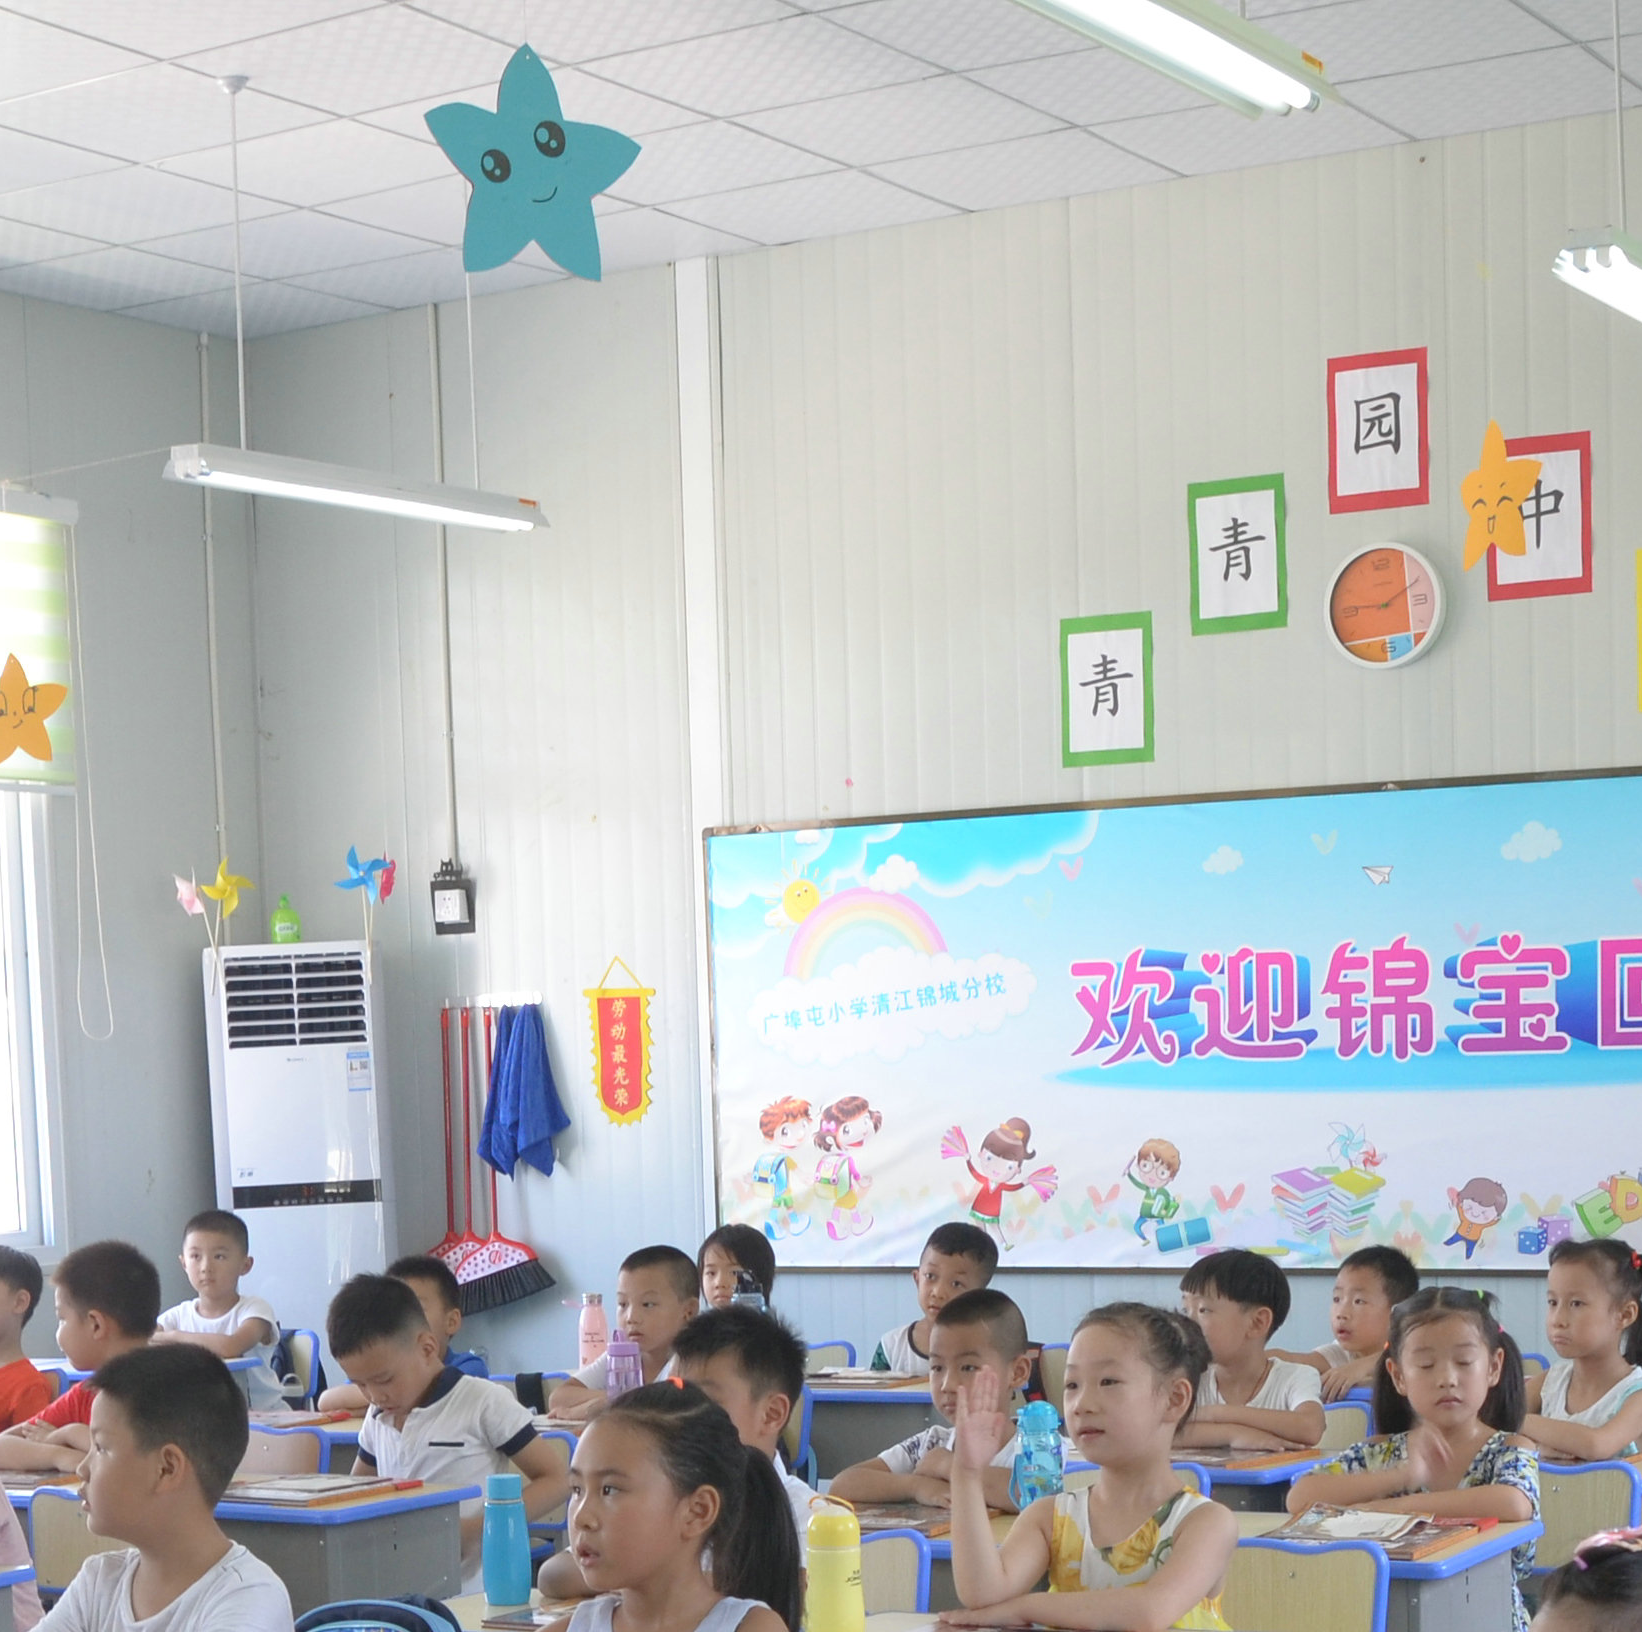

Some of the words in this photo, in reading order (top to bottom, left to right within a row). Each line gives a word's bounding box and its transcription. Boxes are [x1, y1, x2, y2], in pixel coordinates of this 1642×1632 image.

[1353, 391, 1403, 456] 园
[1209, 516, 1266, 583] 青
[1079, 654, 1133, 718] 青
[762, 972, 1009, 1036] 广埠屯小学清江锦城分校
[610, 998, 629, 1107] 劳动最光荣
